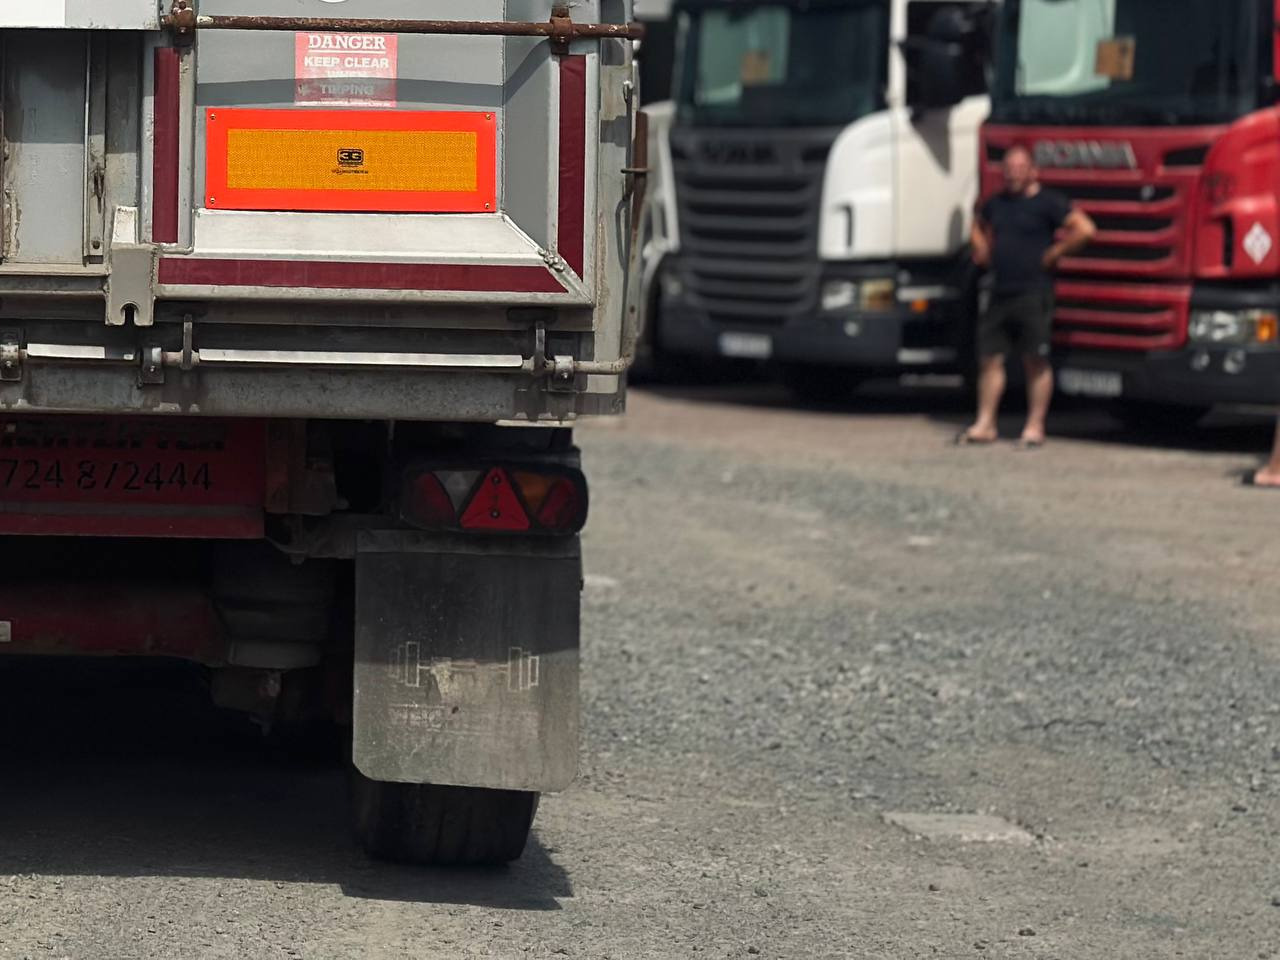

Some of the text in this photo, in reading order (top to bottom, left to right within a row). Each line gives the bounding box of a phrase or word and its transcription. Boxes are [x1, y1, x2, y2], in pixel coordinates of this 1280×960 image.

[307, 34, 386, 50] DANGER
[303, 55, 390, 70] KEEP CLEAR
